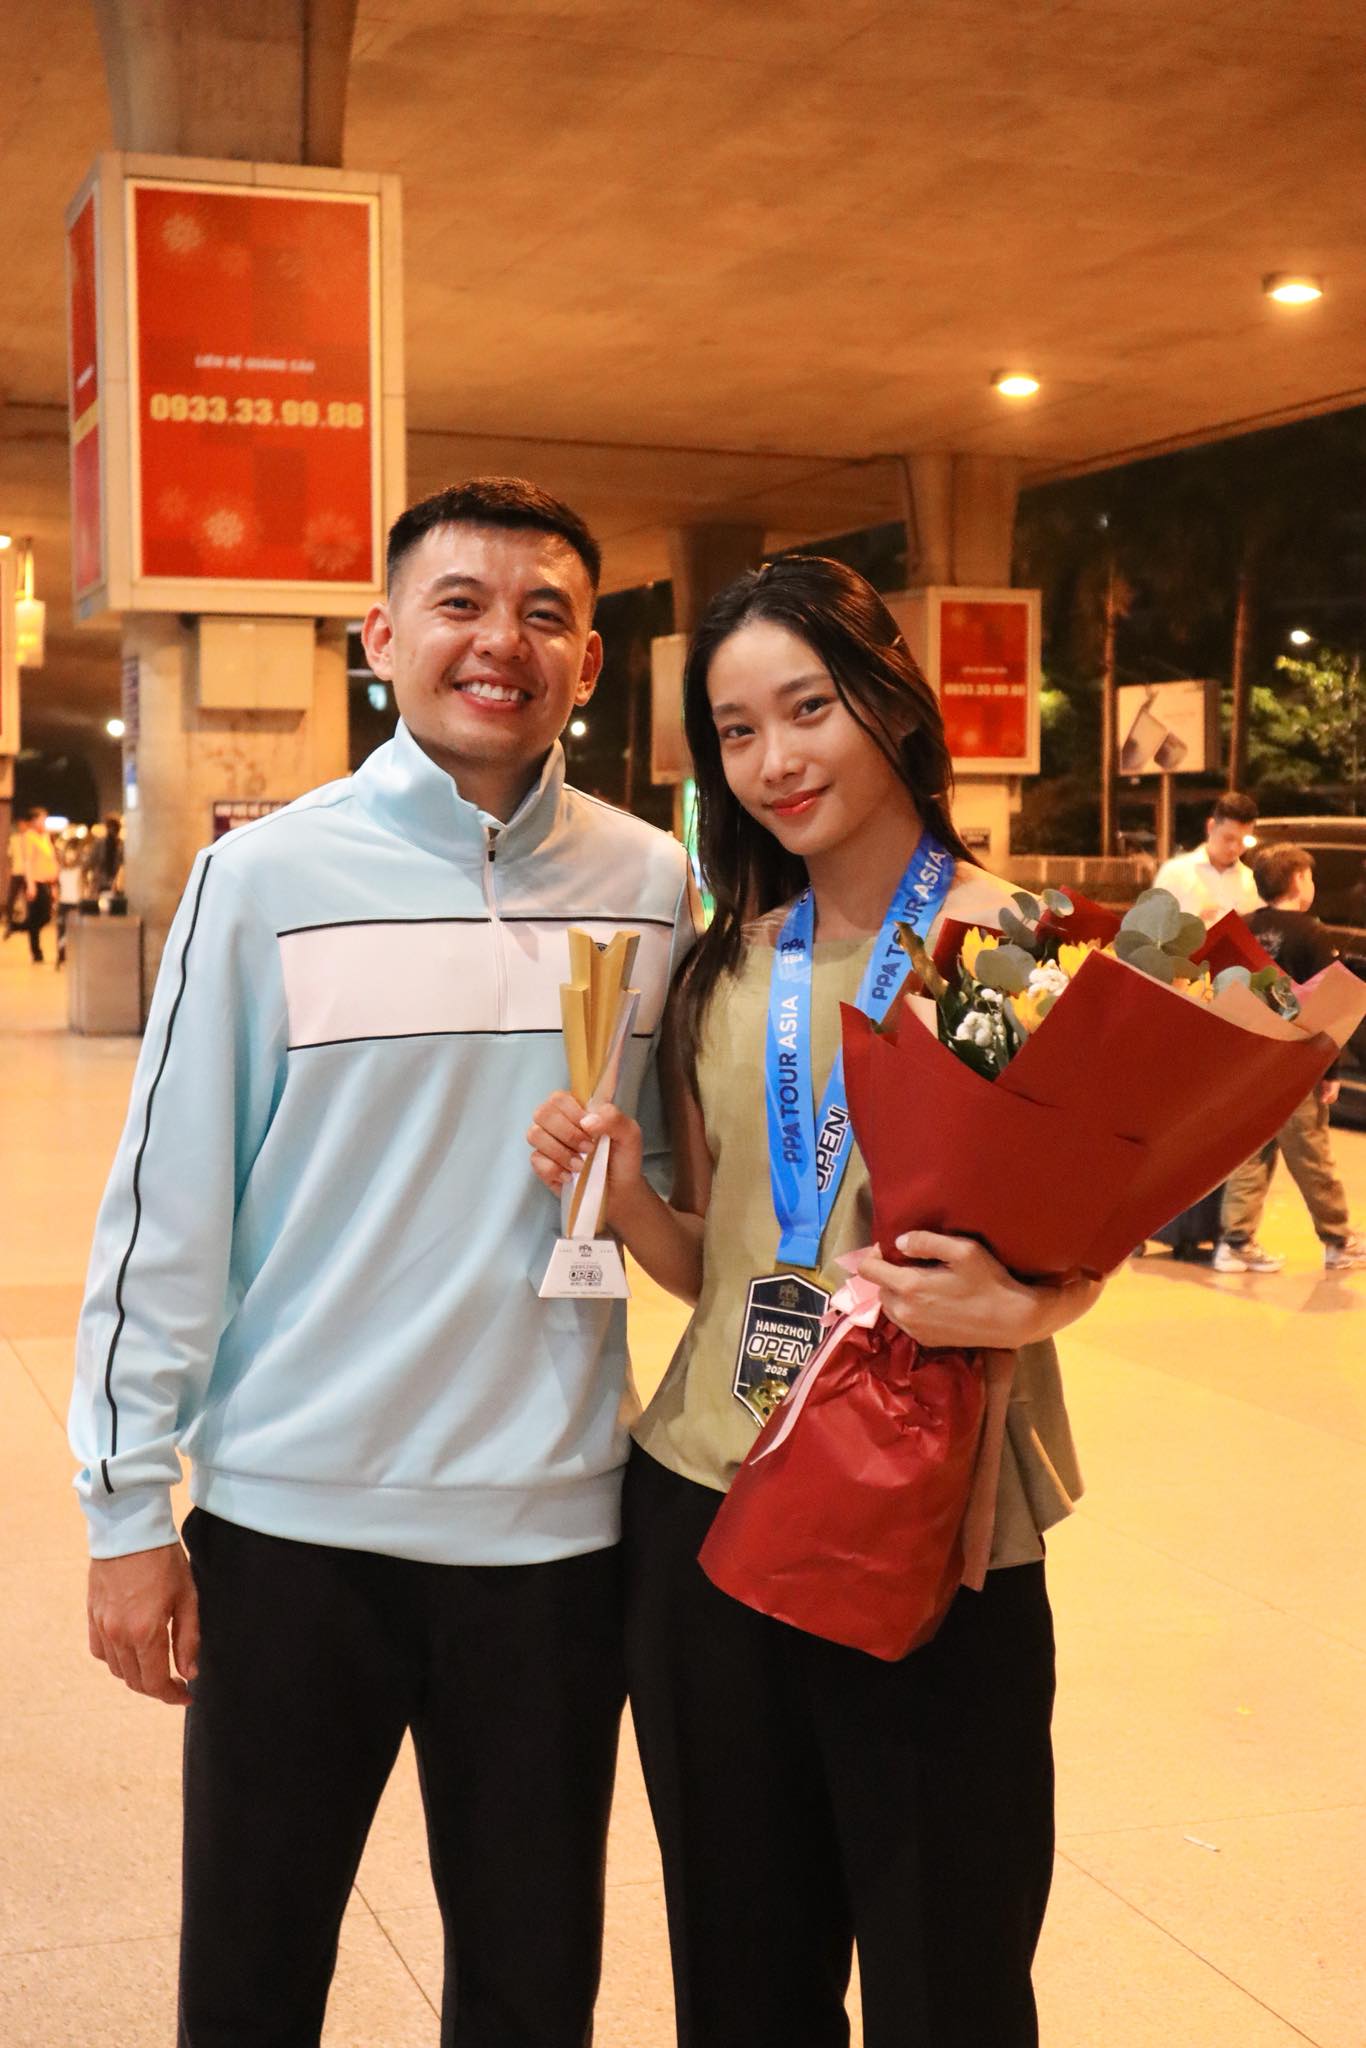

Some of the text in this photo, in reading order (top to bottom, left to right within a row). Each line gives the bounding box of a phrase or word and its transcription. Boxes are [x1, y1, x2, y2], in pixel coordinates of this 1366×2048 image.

[871, 961, 901, 1000] PPA
[913, 851, 946, 899] ASIA
[778, 995, 803, 1165] PPA TOUR ASIA
[568, 1270, 603, 1282] OPEN
[755, 1320, 812, 1342] HANGZHOU
[747, 1334, 813, 1365] OPEN
